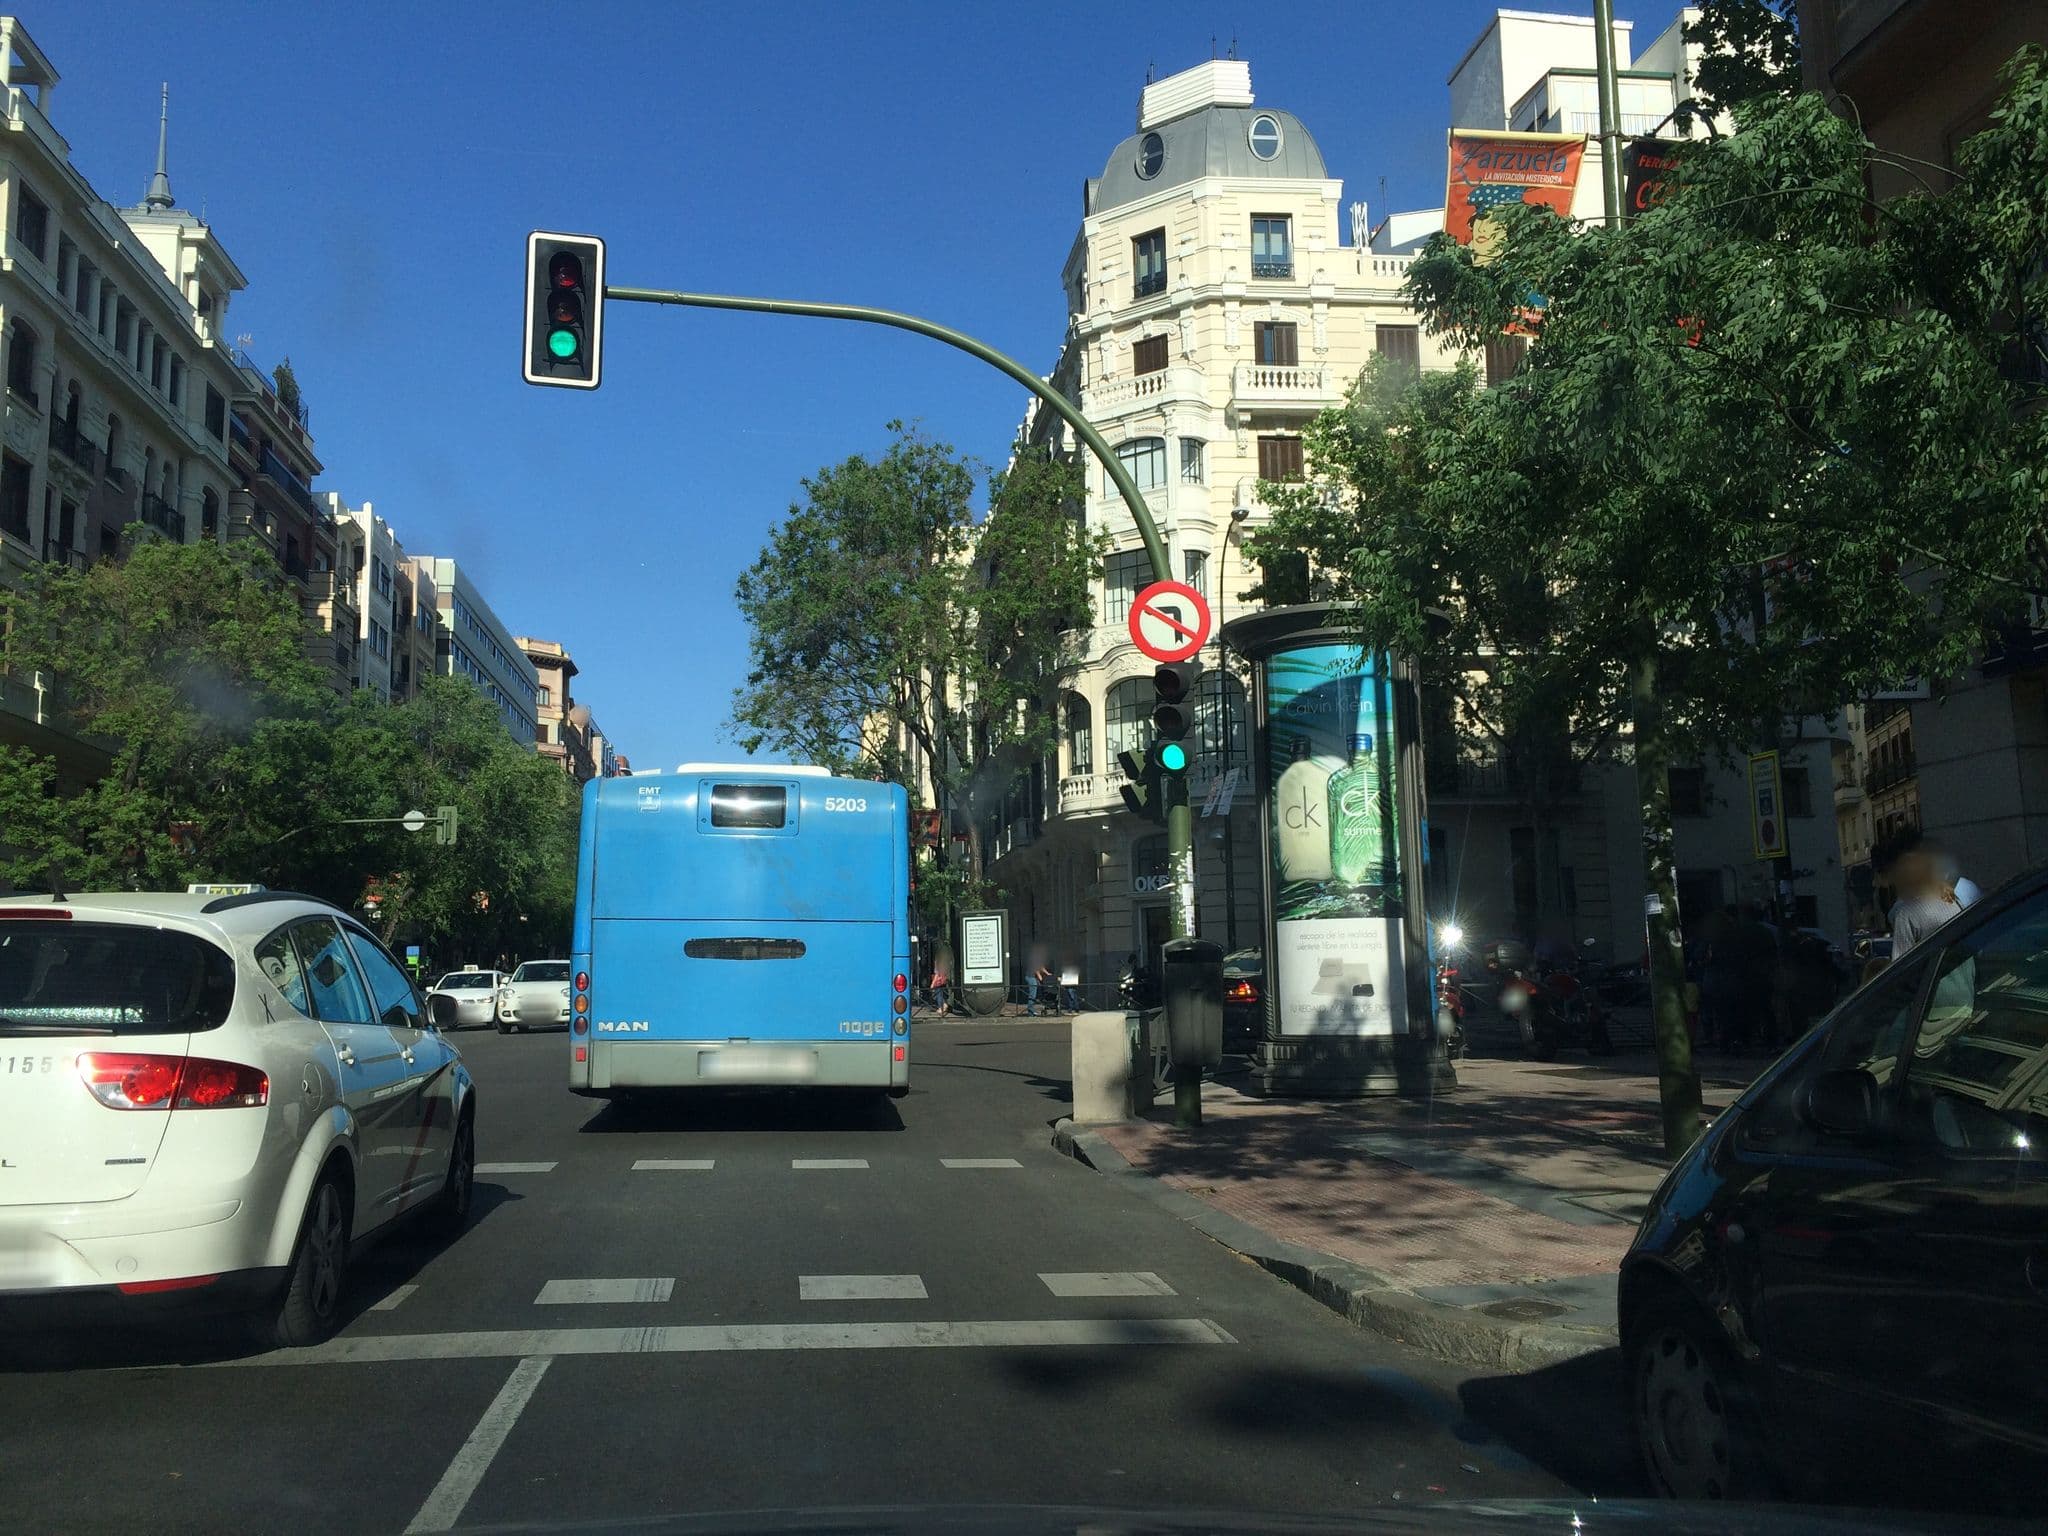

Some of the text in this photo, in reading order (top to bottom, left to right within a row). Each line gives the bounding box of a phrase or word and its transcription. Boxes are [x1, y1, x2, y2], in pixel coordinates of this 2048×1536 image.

[1484, 172, 1562, 184] LA INVITACIÓN MISTERIOSA
[1286, 694, 1373, 717] Calvin Klein
[639, 786, 661, 795] EMT
[1341, 770, 1384, 817] ck
[825, 797, 867, 812] 5203
[1285, 785, 1321, 829] ck
[210, 887, 248, 895] TAXI
[598, 1021, 649, 1032] MAN
